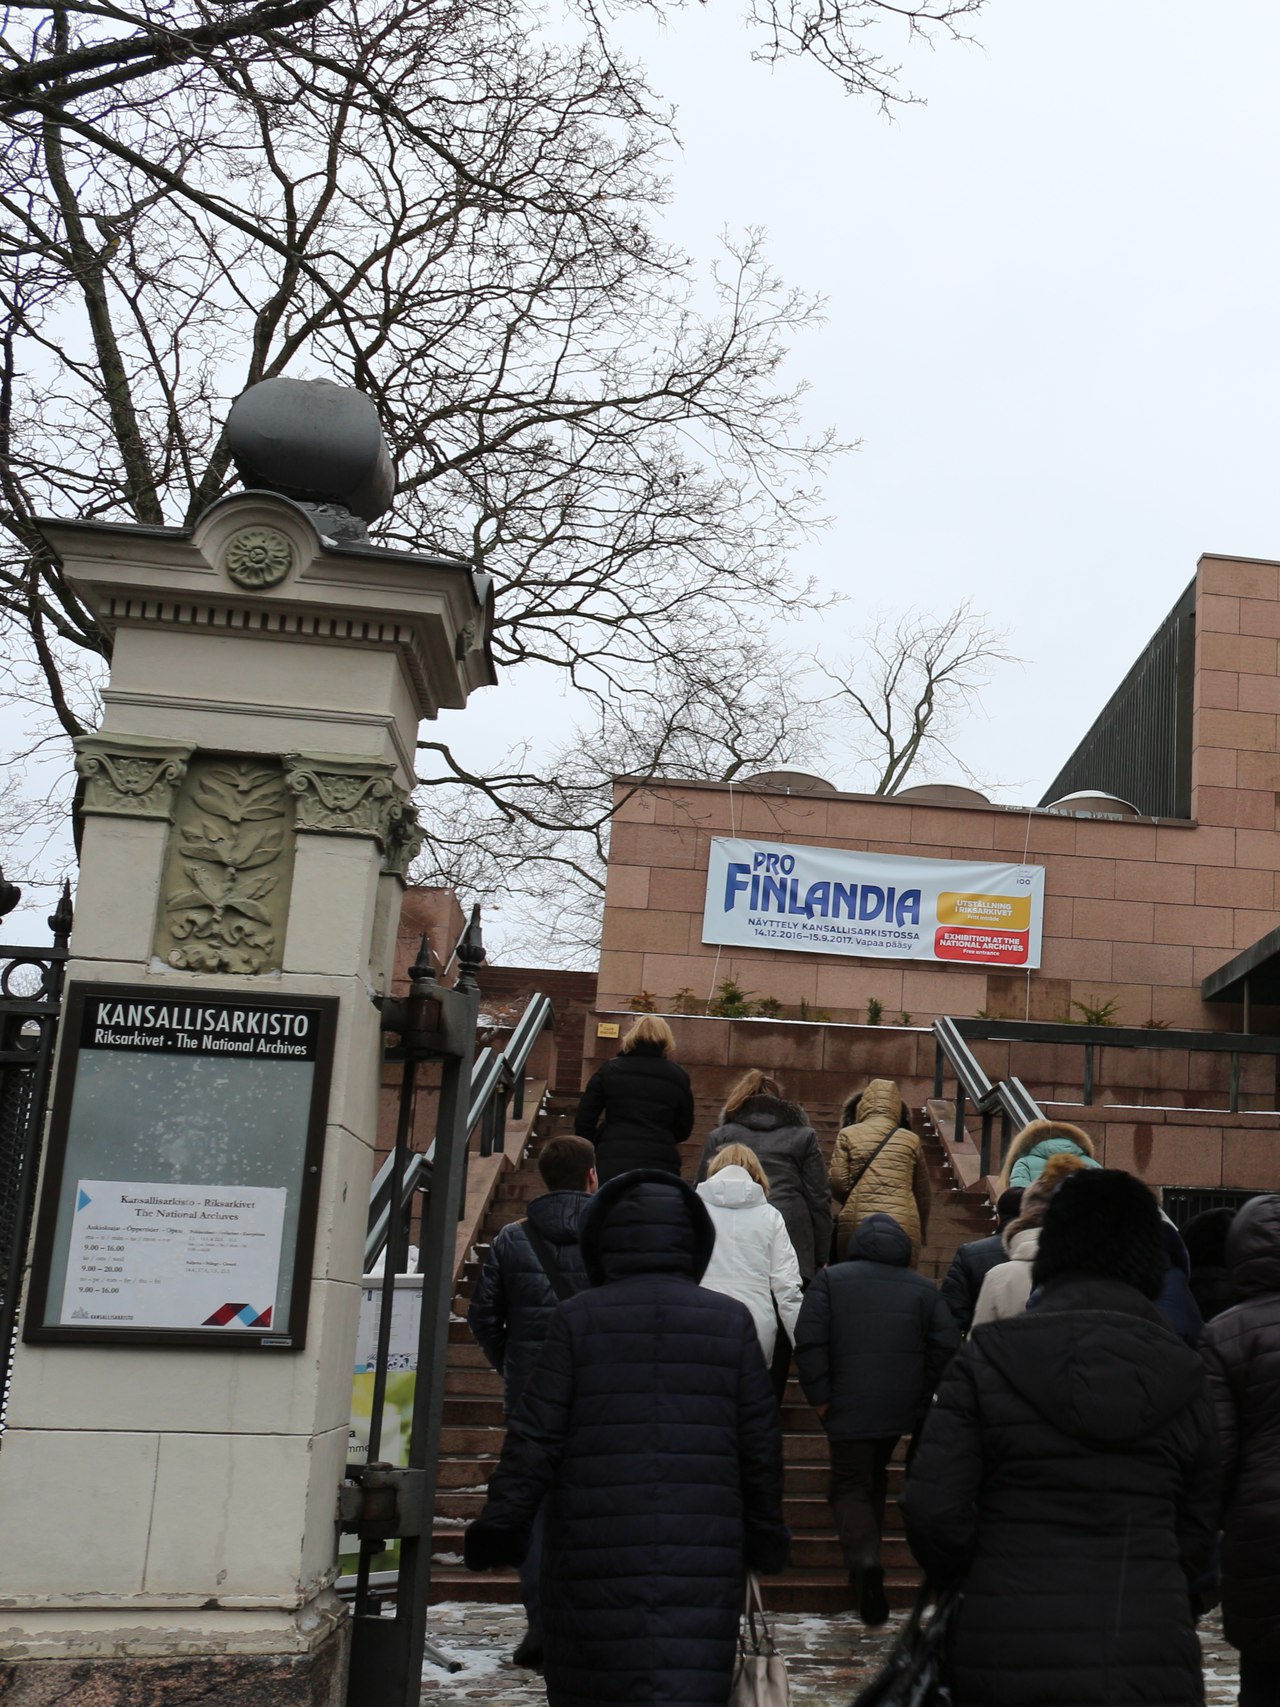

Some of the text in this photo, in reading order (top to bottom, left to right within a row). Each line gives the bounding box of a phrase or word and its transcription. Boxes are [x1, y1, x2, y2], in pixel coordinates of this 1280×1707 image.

[753, 852, 795, 875] PRO
[724, 863, 921, 927] FINLANDIA
[957, 899, 1012, 910] UTSTÄLLNING
[959, 906, 1013, 917] RIKSARKIVET
[748, 918, 920, 940] NÄYTTELY KANSALLISARKISTOSSA
[855, 938, 884, 949] Vapaa
[885, 940, 913, 950] pääsy
[940, 939, 1024, 952] NATIONAL ARCHIVES
[944, 933, 991, 943] EXHIBITION
[1004, 937, 1020, 945] THE
[97, 1002, 309, 1037] KANSALLISARKISTO
[94, 1029, 307, 1055] Riksarkivet The National Archives
[120, 1195, 195, 1207] Kansallisarkisto
[204, 1199, 256, 1209] Riksarkivet
[134, 1208, 239, 1222] The National Archives
